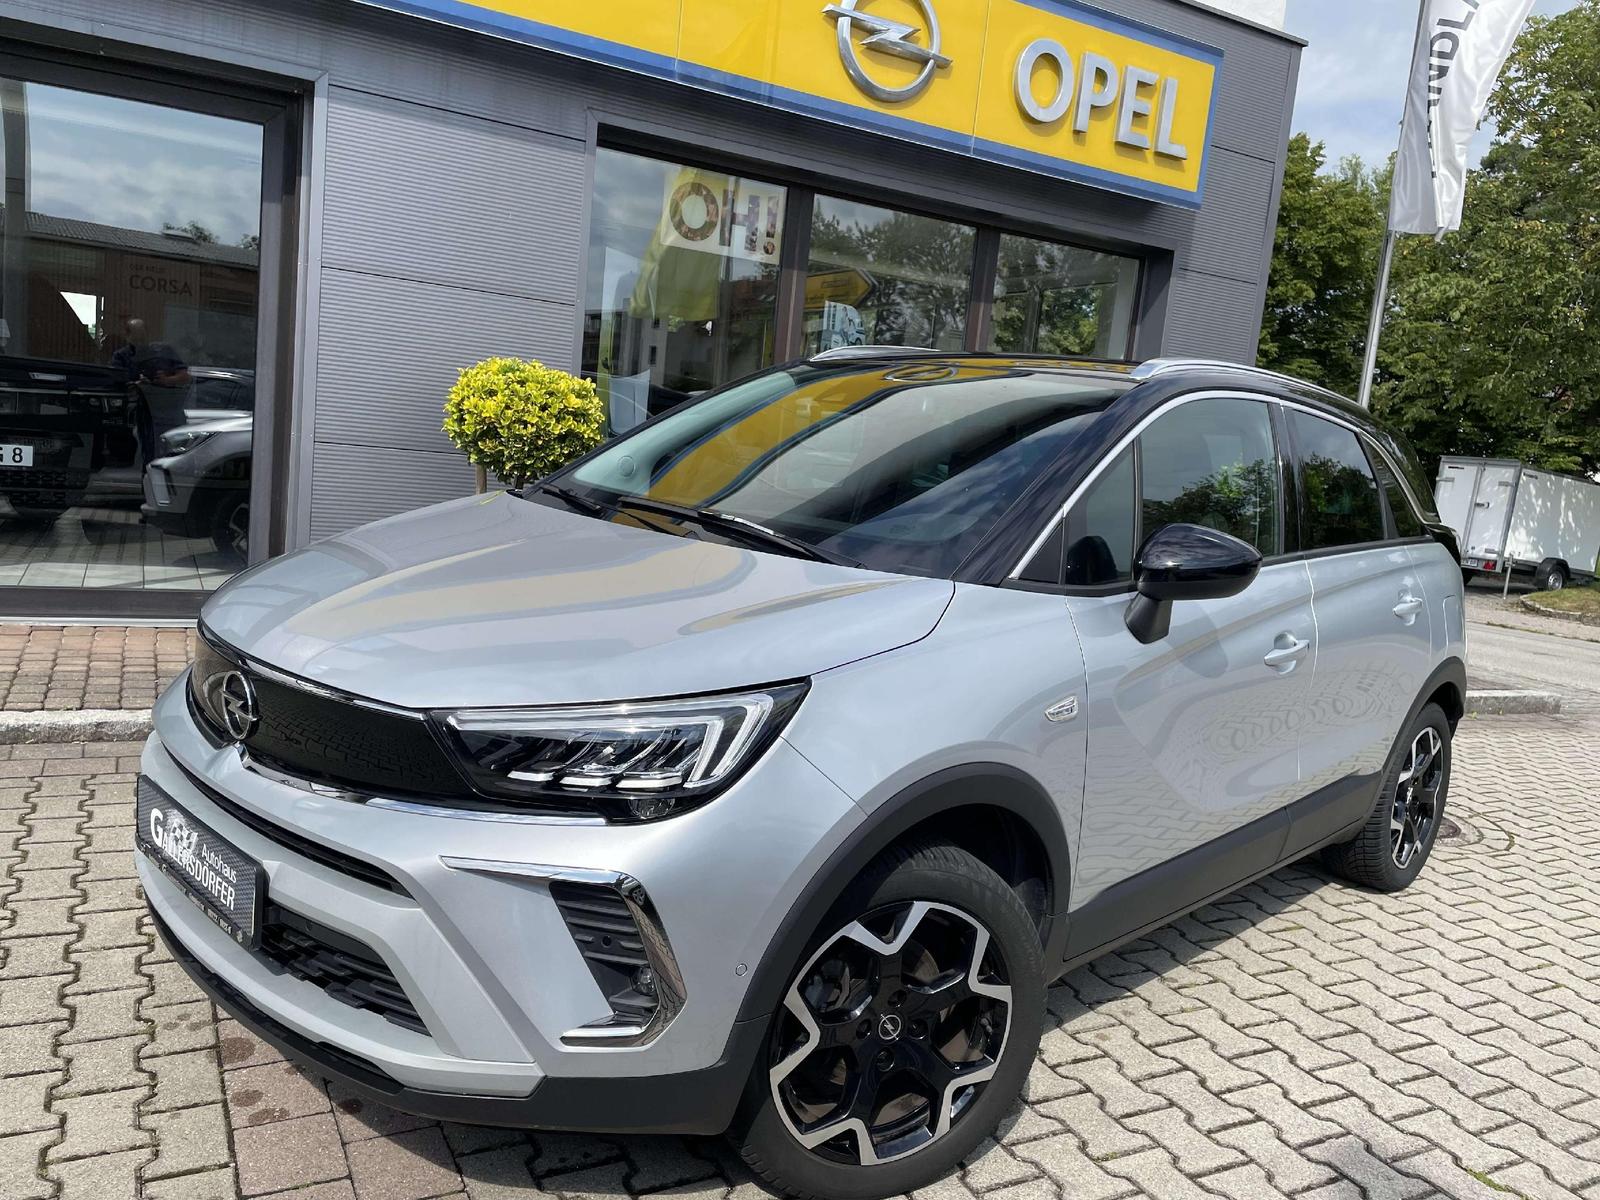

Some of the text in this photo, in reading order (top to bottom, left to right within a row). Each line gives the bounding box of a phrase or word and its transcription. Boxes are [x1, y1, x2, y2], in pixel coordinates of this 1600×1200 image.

[1013, 38, 1187, 160] OPEL
[669, 182, 779, 255] OH!
[129, 275, 193, 296] CORSA
[201, 844, 237, 883] Autohaus
